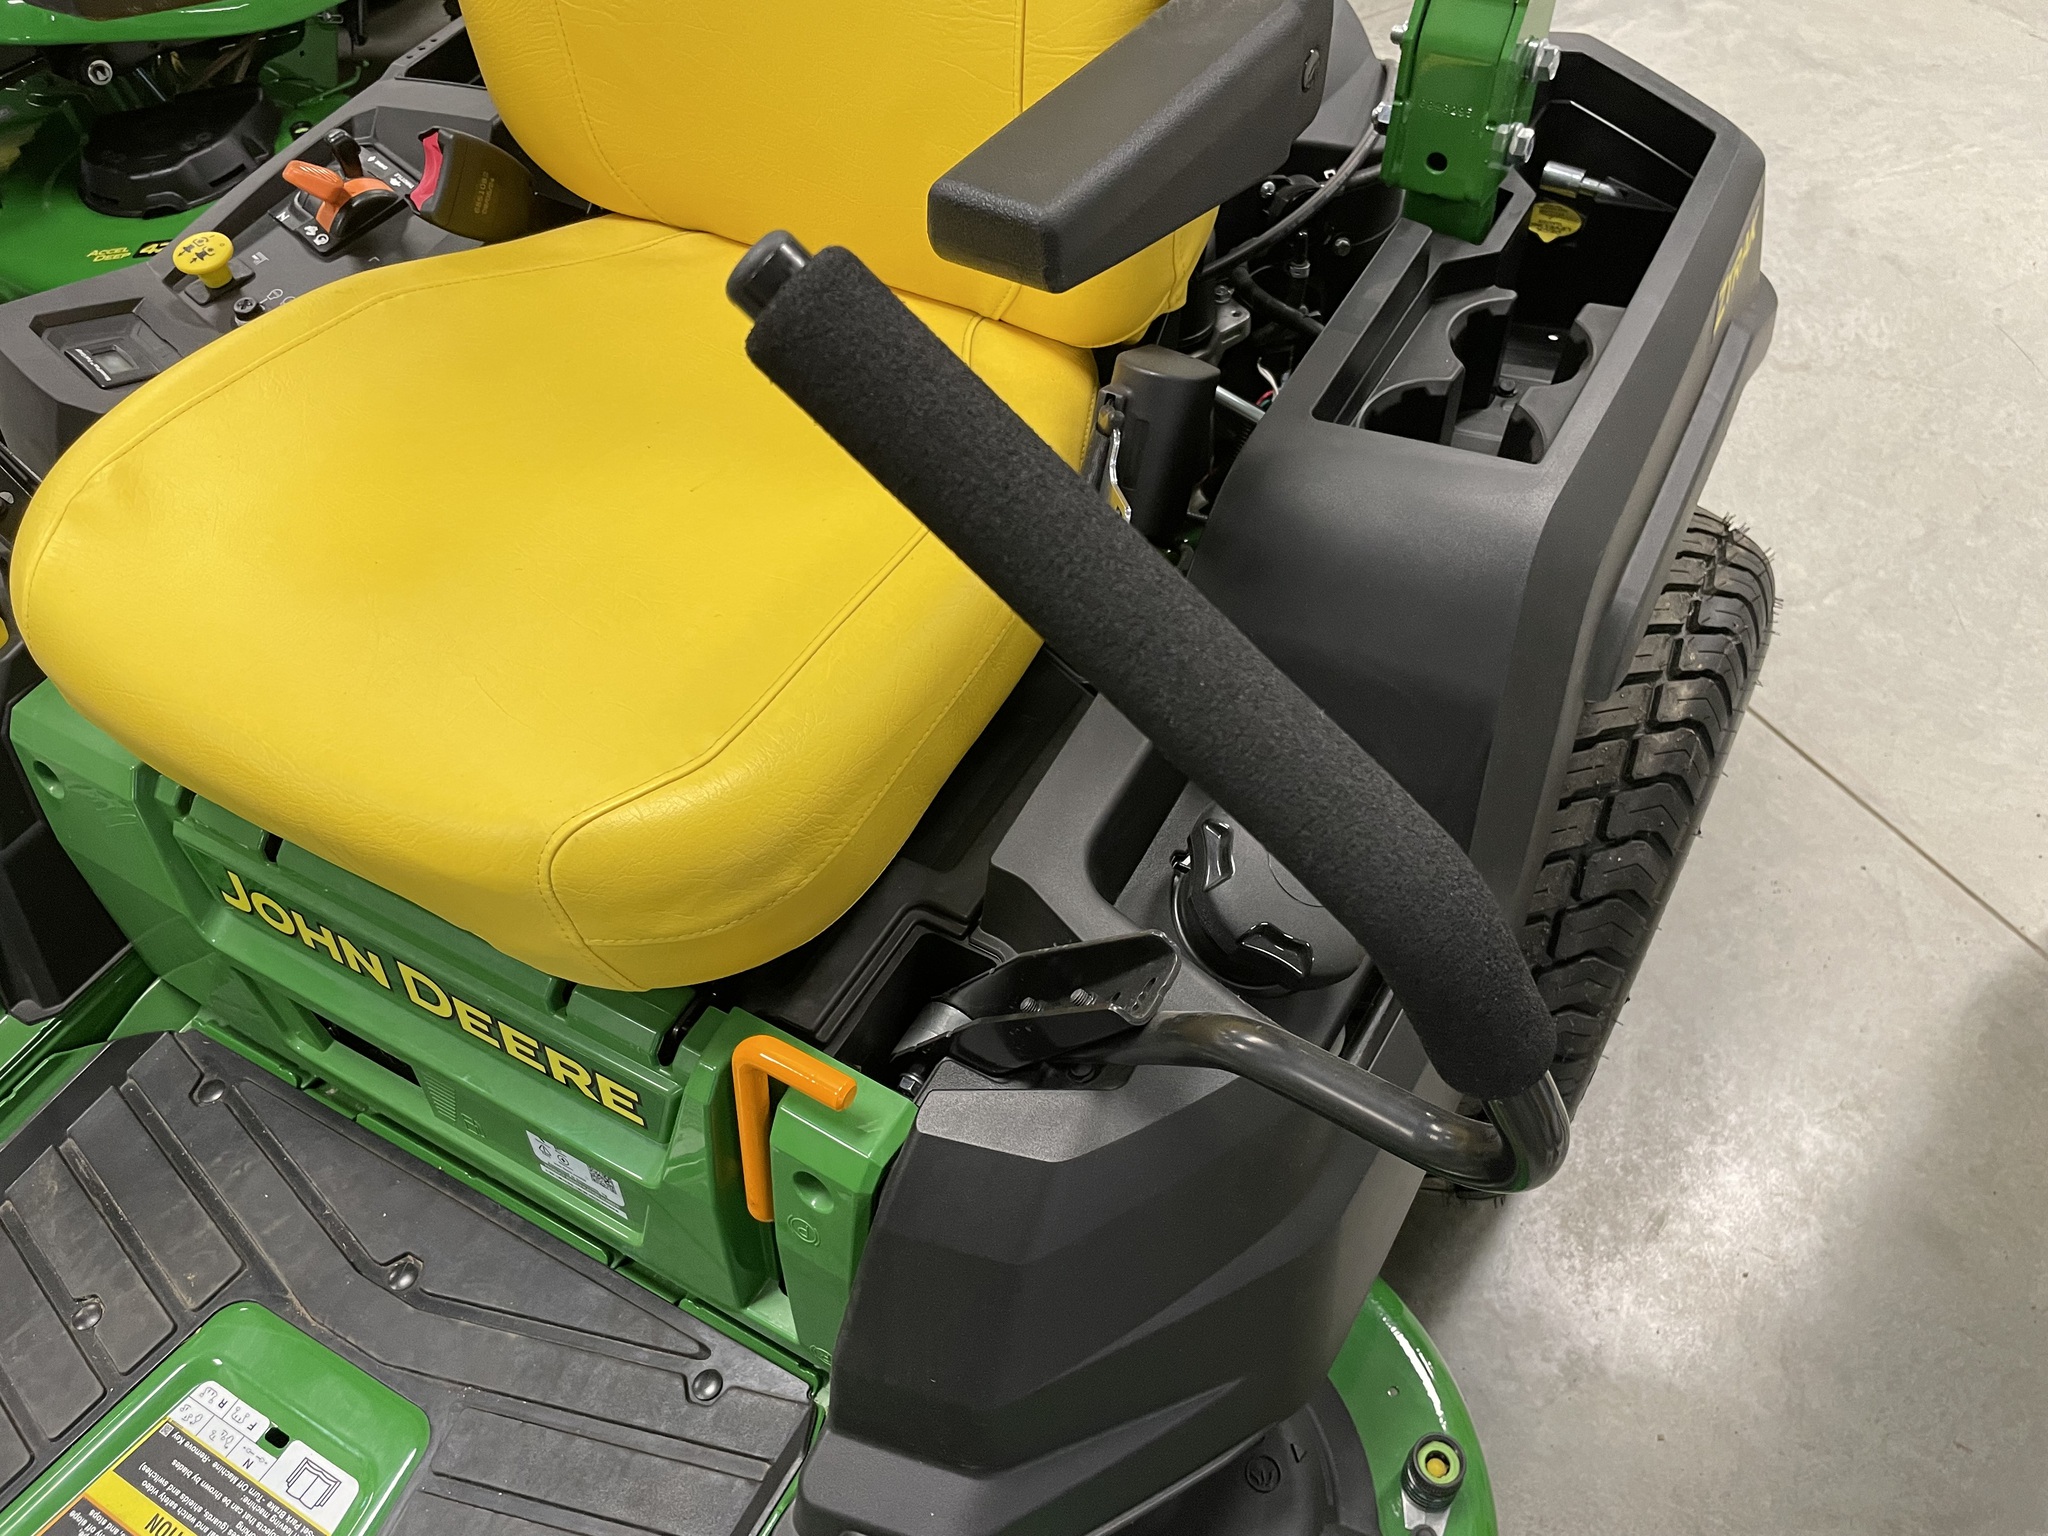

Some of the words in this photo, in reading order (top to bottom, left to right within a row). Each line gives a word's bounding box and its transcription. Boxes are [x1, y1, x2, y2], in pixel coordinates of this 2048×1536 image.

[86, 247, 129, 258] ACCEL
[93, 252, 131, 262] DEEP
[221, 869, 392, 990] JOHN
[396, 960, 645, 1127] DEERE
[217, 1397, 229, 1410] R
[246, 1422, 258, 1432] F
[171, 1431, 186, 1446] Key
[171, 1459, 194, 1479] blades
[241, 1457, 255, 1471] N
[138, 1461, 169, 1487] switches)
[190, 1473, 202, 1485] by
[211, 1461, 240, 1485] Machine
[141, 1479, 160, 1496] video
[165, 1483, 182, 1497] and
[199, 1480, 223, 1501] thrown
[235, 1479, 249, 1492] Off
[157, 1491, 179, 1510] safety
[179, 1493, 204, 1513] shields
[221, 1496, 232, 1508] be
[230, 1502, 244, 1515] can
[240, 1494, 271, 1519] machine:
[176, 1506, 197, 1524] watch
[266, 1500, 287, 1520] Brake
[203, 1508, 230, 1534] (guards,
[241, 1511, 258, 1526] that
[285, 1514, 303, 1531] Park
[193, 1520, 210, 1534] and
